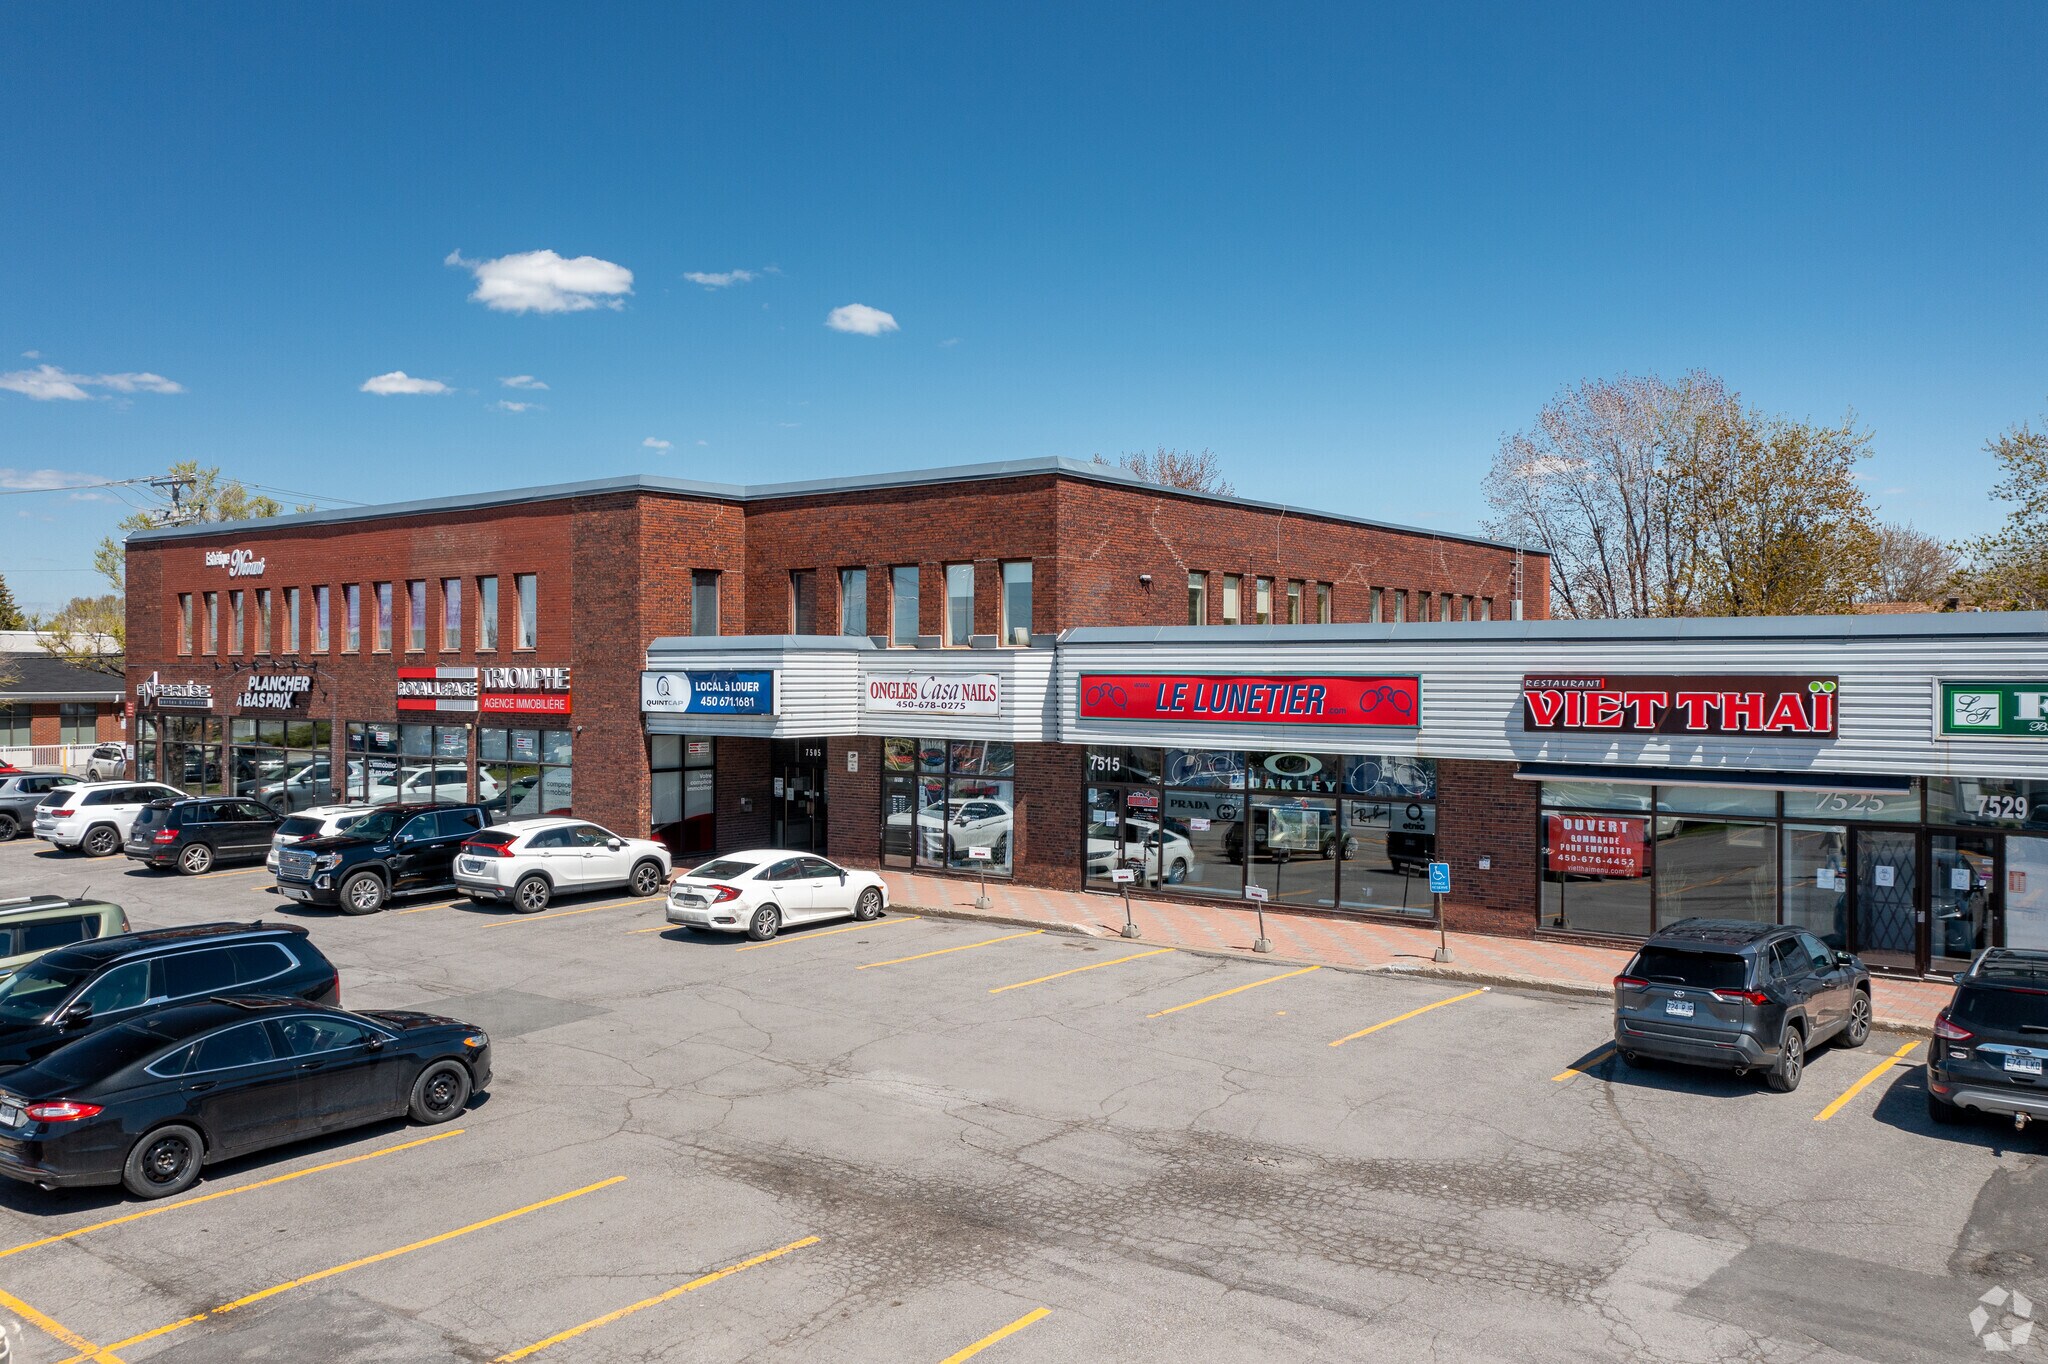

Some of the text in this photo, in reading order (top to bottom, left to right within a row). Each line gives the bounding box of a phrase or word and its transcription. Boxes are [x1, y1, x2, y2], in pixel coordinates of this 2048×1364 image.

[248, 675, 310, 692] PLANCHER
[481, 667, 571, 690] TRIOMPHE
[1525, 679, 1601, 689] RESTAURANT
[695, 681, 724, 692] LOCAL
[731, 682, 759, 692] LOUER
[870, 675, 997, 702] ONGLES Casa NAILS
[484, 697, 565, 710] AGENCE IMMOBILIÈRE
[700, 696, 755, 707] 450 671.1681
[896, 700, 966, 710] 450-678-0275
[1156, 683, 1188, 712] LE
[1193, 683, 1327, 715] LUNETIER
[1523, 681, 1837, 733] VIET THAÏ
[805, 748, 822, 757] 7505
[1090, 754, 1120, 771] 7515
[1170, 799, 1210, 810] PRADA
[1815, 793, 1885, 812] 7525
[1975, 795, 2028, 819] 7529
[1563, 818, 1629, 833] OUVERT
[1560, 843, 1632, 855] POUR EMPORTER
[1558, 854, 1635, 866] 450-676-4452
[1567, 865, 1625, 874] vietthaimenu.com
